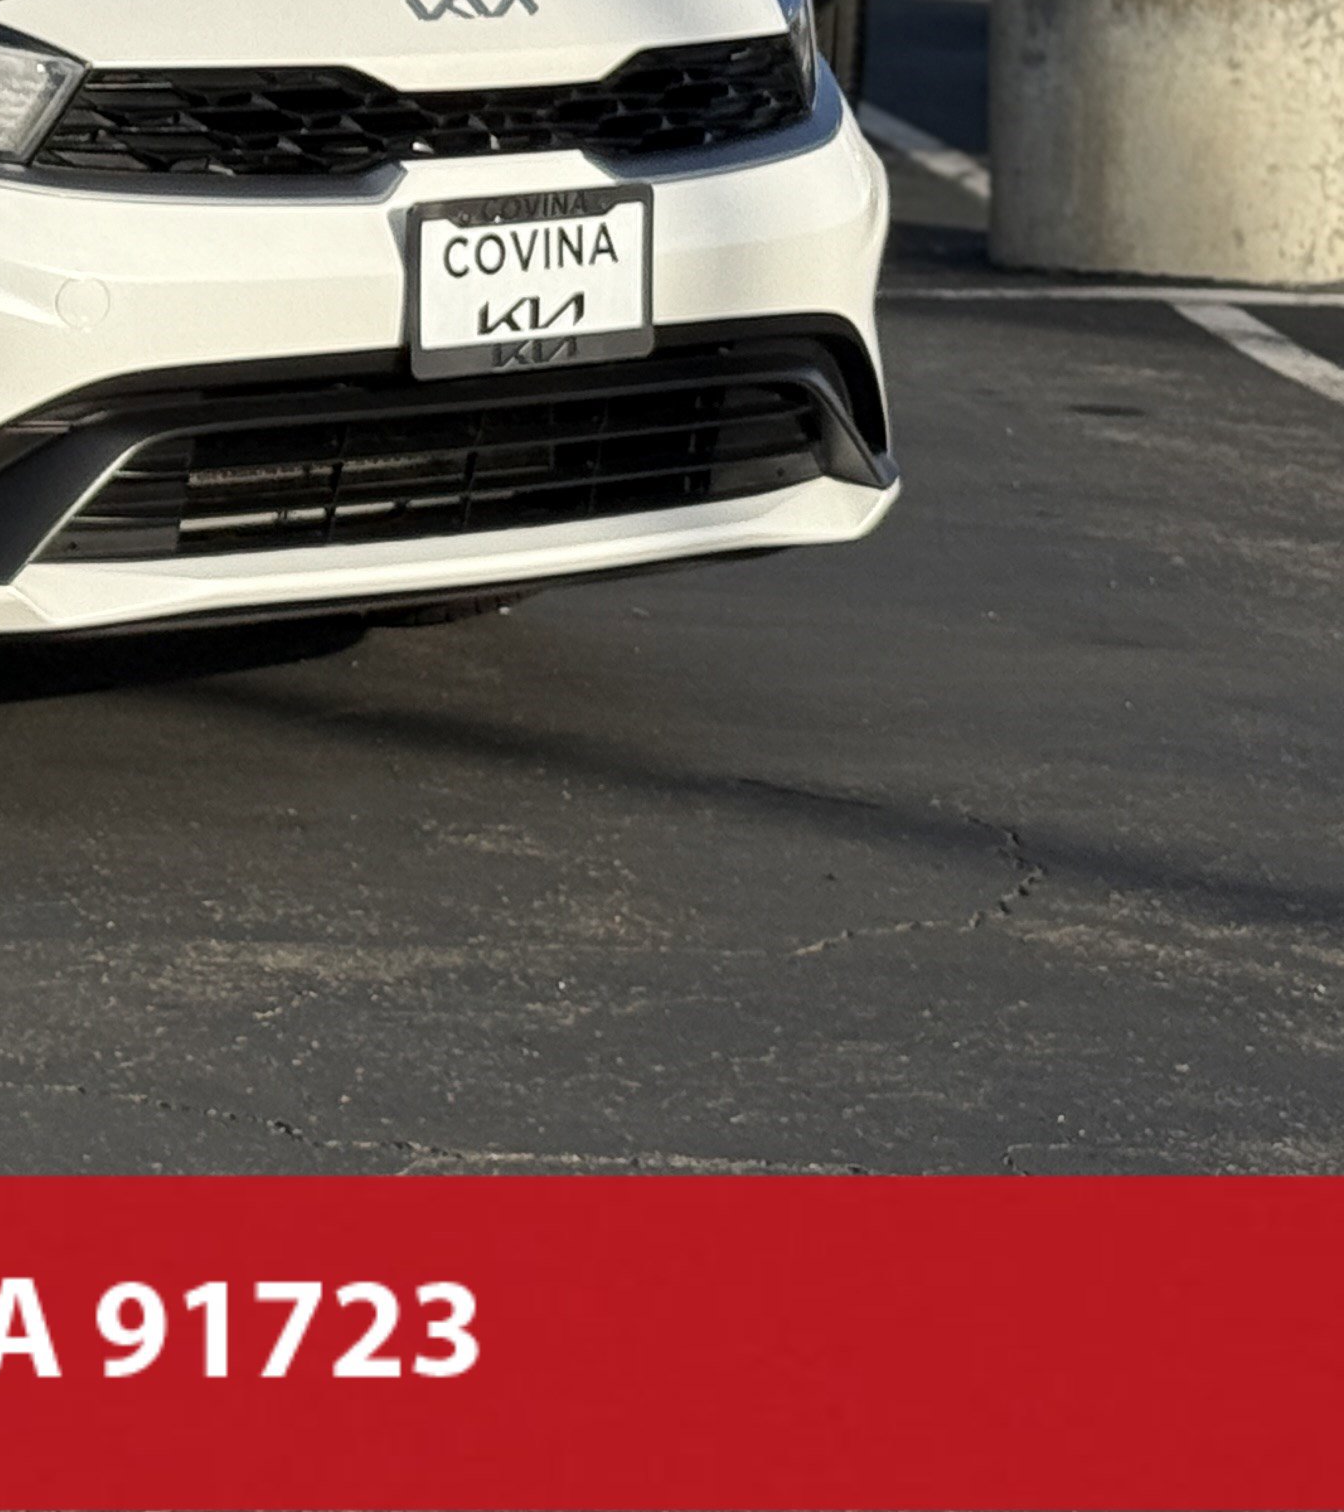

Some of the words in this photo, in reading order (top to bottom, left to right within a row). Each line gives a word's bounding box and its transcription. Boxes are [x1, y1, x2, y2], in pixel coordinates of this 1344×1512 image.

[482, 190, 587, 219] COVINA
[443, 222, 619, 278] COVINA
[477, 291, 585, 335] KIA
[491, 336, 578, 368] KIA
